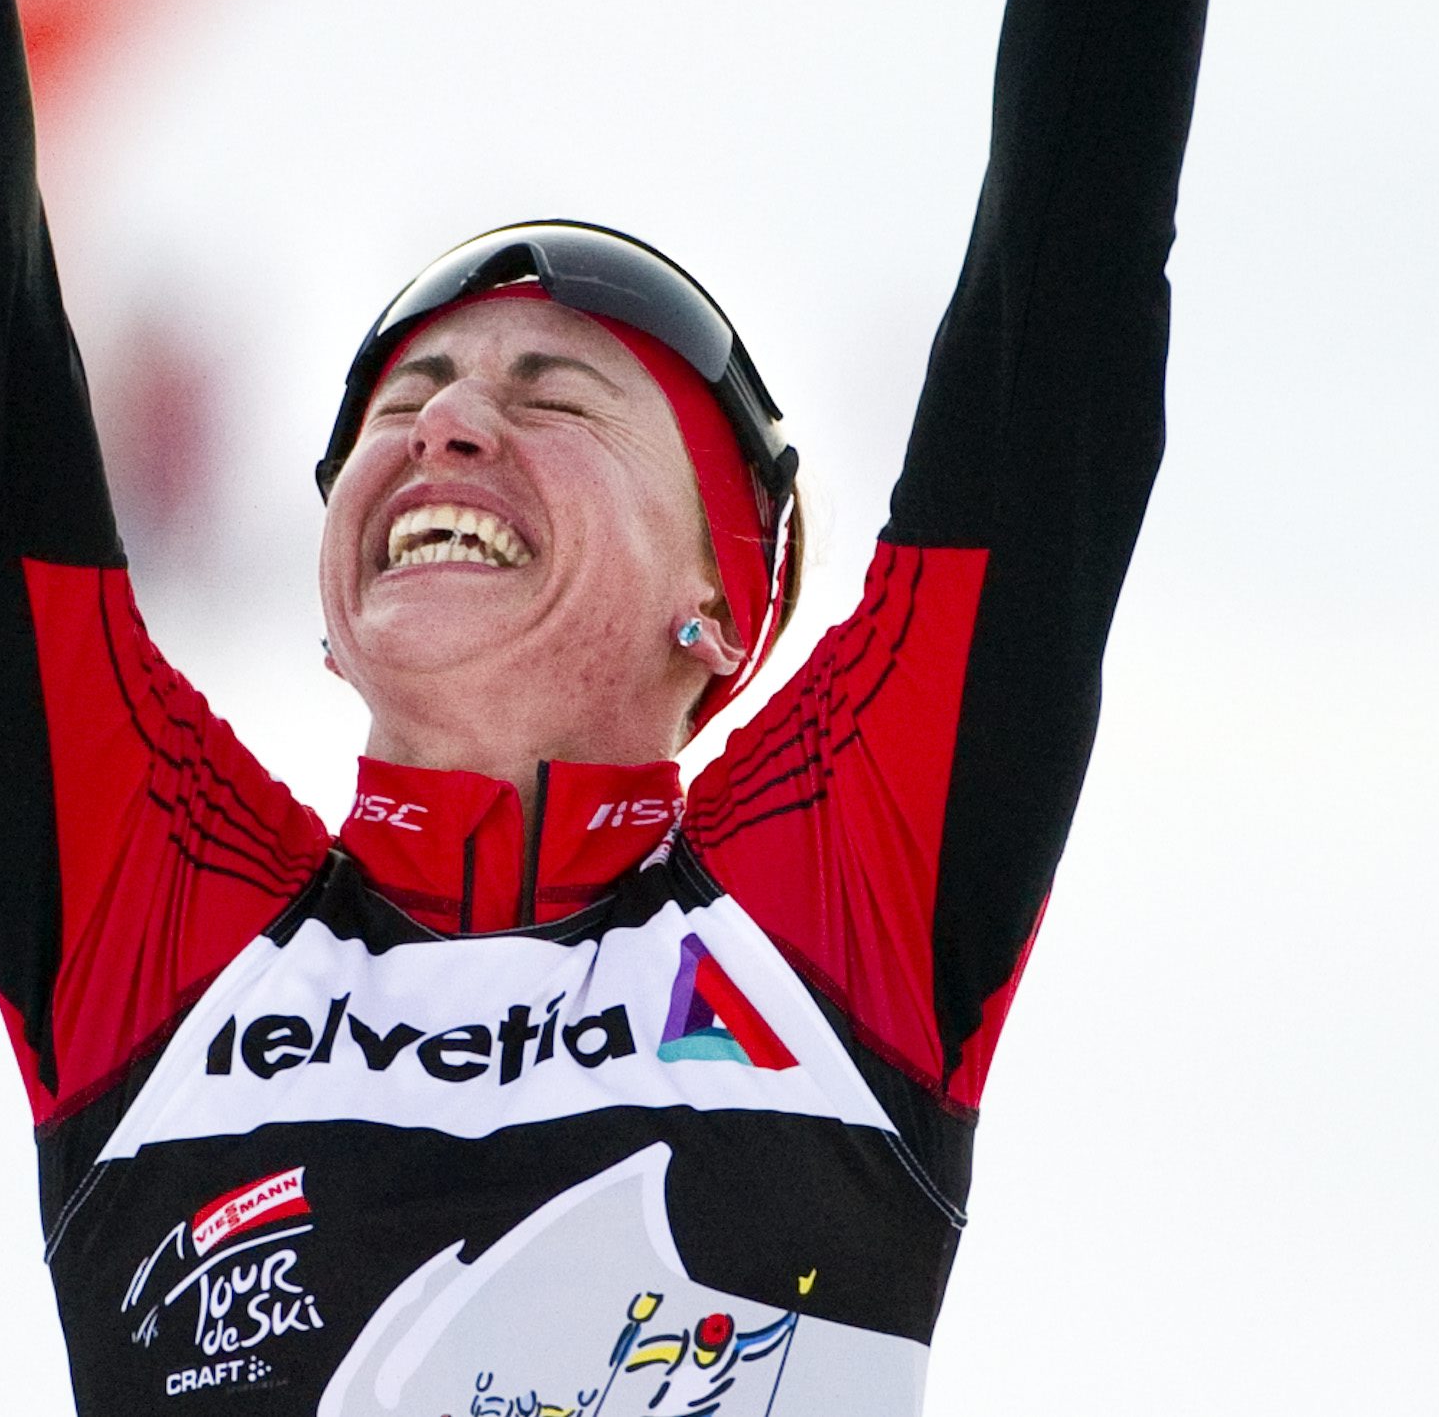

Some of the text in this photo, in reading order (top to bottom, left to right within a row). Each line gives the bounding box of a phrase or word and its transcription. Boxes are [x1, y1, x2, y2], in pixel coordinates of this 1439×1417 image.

[195, 1177, 298, 1243] VIESSMANN
[202, 1319, 241, 1356] de
[166, 1360, 245, 1396] CRAFT
